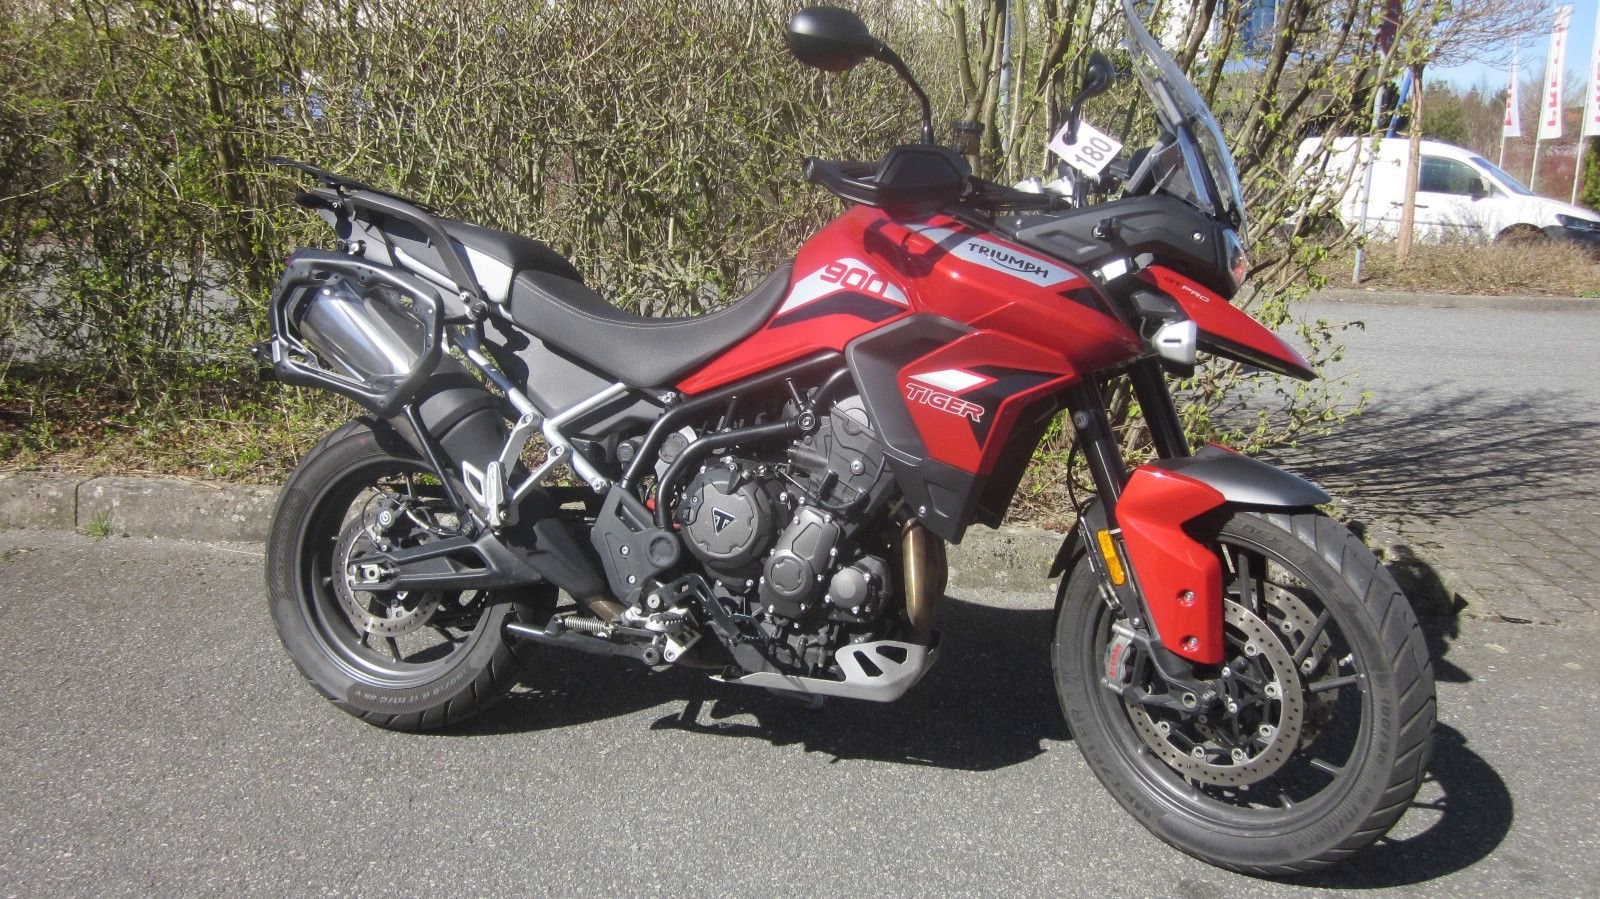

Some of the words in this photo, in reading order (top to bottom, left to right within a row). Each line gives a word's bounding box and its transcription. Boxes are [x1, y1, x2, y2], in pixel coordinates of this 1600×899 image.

[1075, 136, 1112, 168] 180
[968, 242, 1048, 279] TRIUMPH
[820, 262, 890, 297] 900
[1181, 285, 1209, 302] PRO
[905, 383, 984, 423] TIGER
[1107, 643, 1122, 677] brembo
